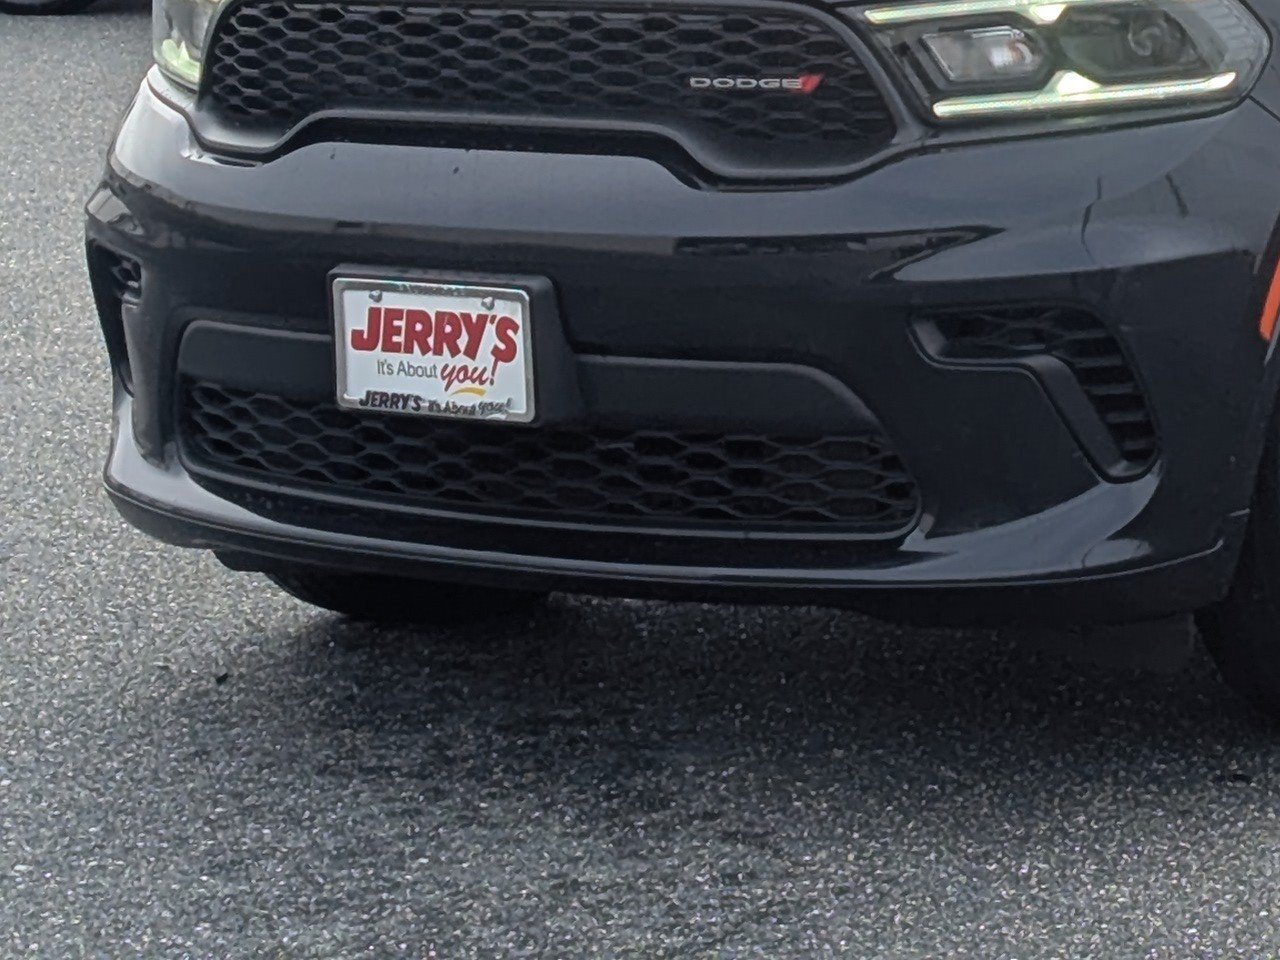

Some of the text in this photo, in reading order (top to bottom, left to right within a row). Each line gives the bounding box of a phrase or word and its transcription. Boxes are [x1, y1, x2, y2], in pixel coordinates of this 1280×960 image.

[689, 76, 802, 89] DODGE
[351, 307, 520, 363] JERRY'S
[377, 357, 500, 392] It's About you!
[359, 390, 424, 412] JERRY'S
